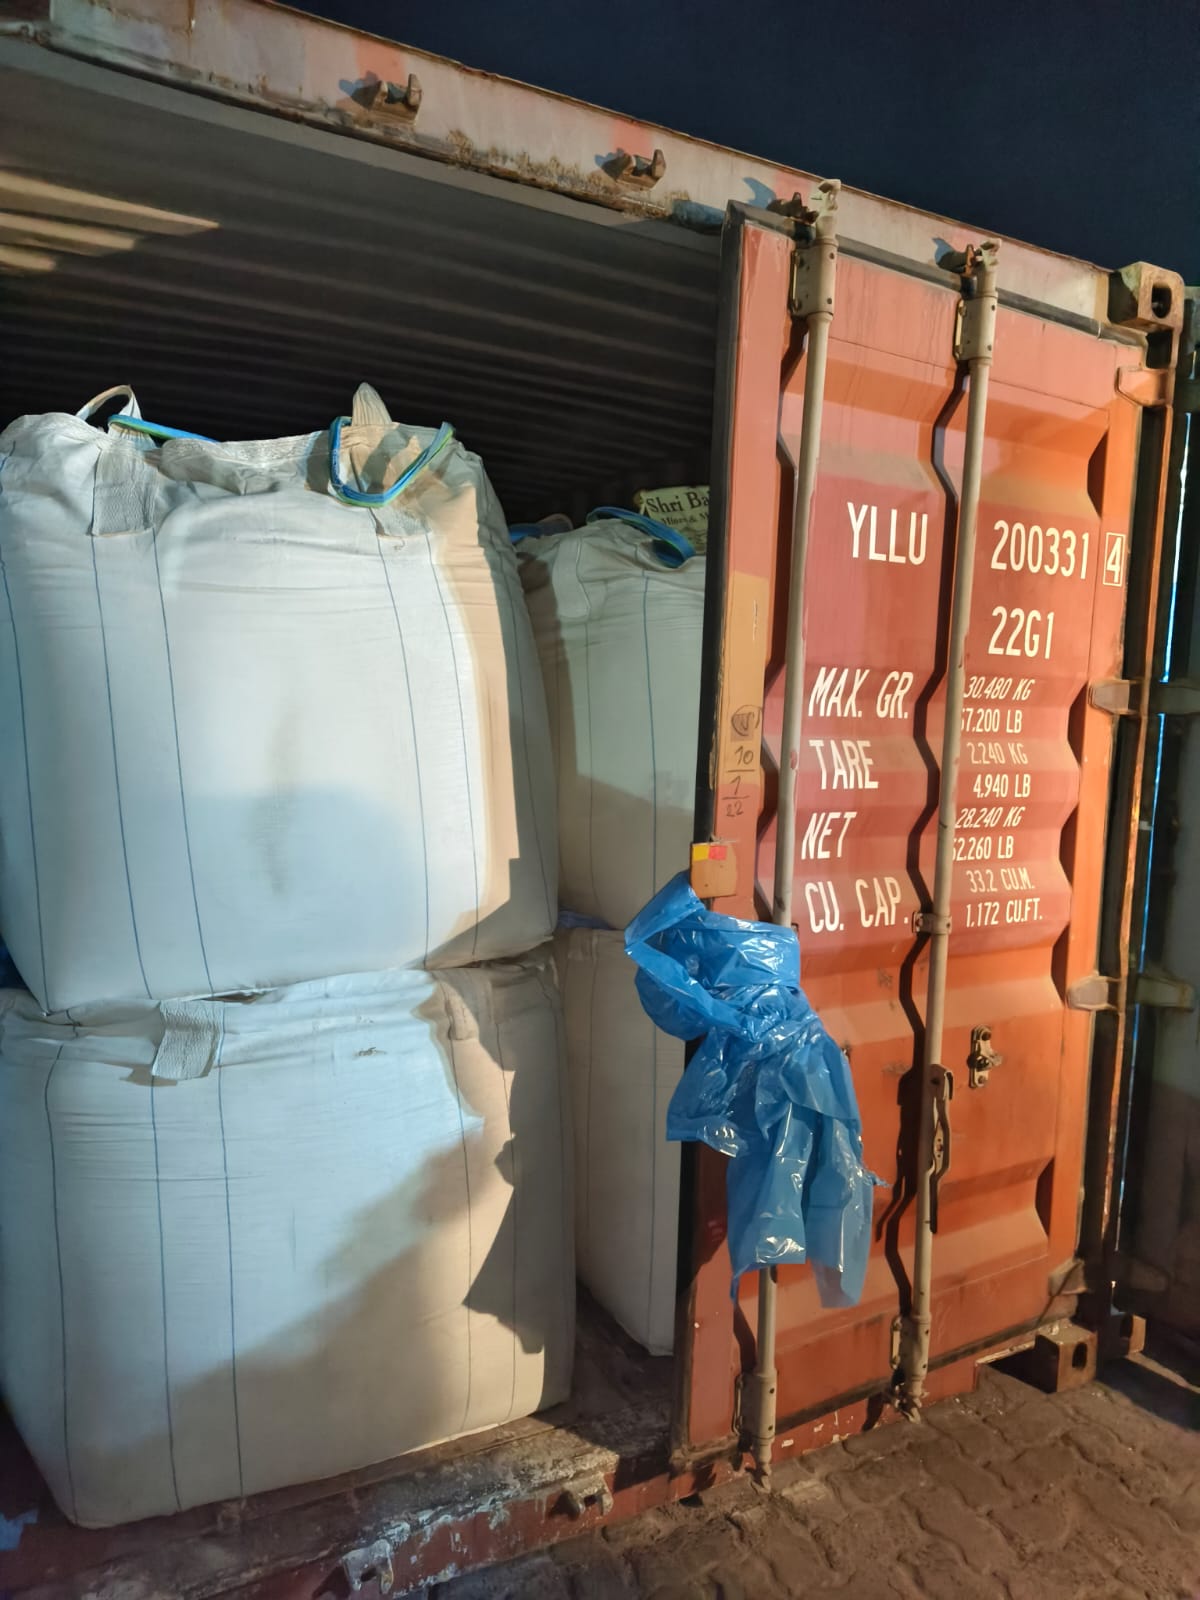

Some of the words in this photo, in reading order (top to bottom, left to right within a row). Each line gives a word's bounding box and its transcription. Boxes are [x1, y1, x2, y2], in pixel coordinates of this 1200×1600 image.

[646, 495, 684, 513] Shri
[686, 491, 709, 509] Ba
[847, 502, 928, 566] YLLU
[991, 520, 1089, 579] 200331
[1106, 536, 1122, 583] 4
[988, 606, 1055, 660] 22G1
[808, 667, 870, 717] MAX.
[876, 671, 914, 719] GR.
[964, 675, 1013, 700] 30.480
[1012, 679, 1036, 701] KG
[1006, 709, 1023, 733] LB
[734, 745, 754, 765] 10
[809, 740, 879, 790] TARE
[966, 742, 1006, 764] 2.240
[1008, 742, 1028, 765] KG
[1014, 774, 1031, 798] LB
[801, 811, 857, 860] NET
[955, 807, 1003, 829] 28.240
[1003, 806, 1025, 828] KG
[998, 835, 1014, 859] LB
[805, 881, 844, 933] CU.
[855, 876, 908, 928] CAP.
[966, 869, 998, 893] 33.2
[1000, 867, 1035, 890] CU.M.
[1006, 898, 1043, 923] CU.FT.
